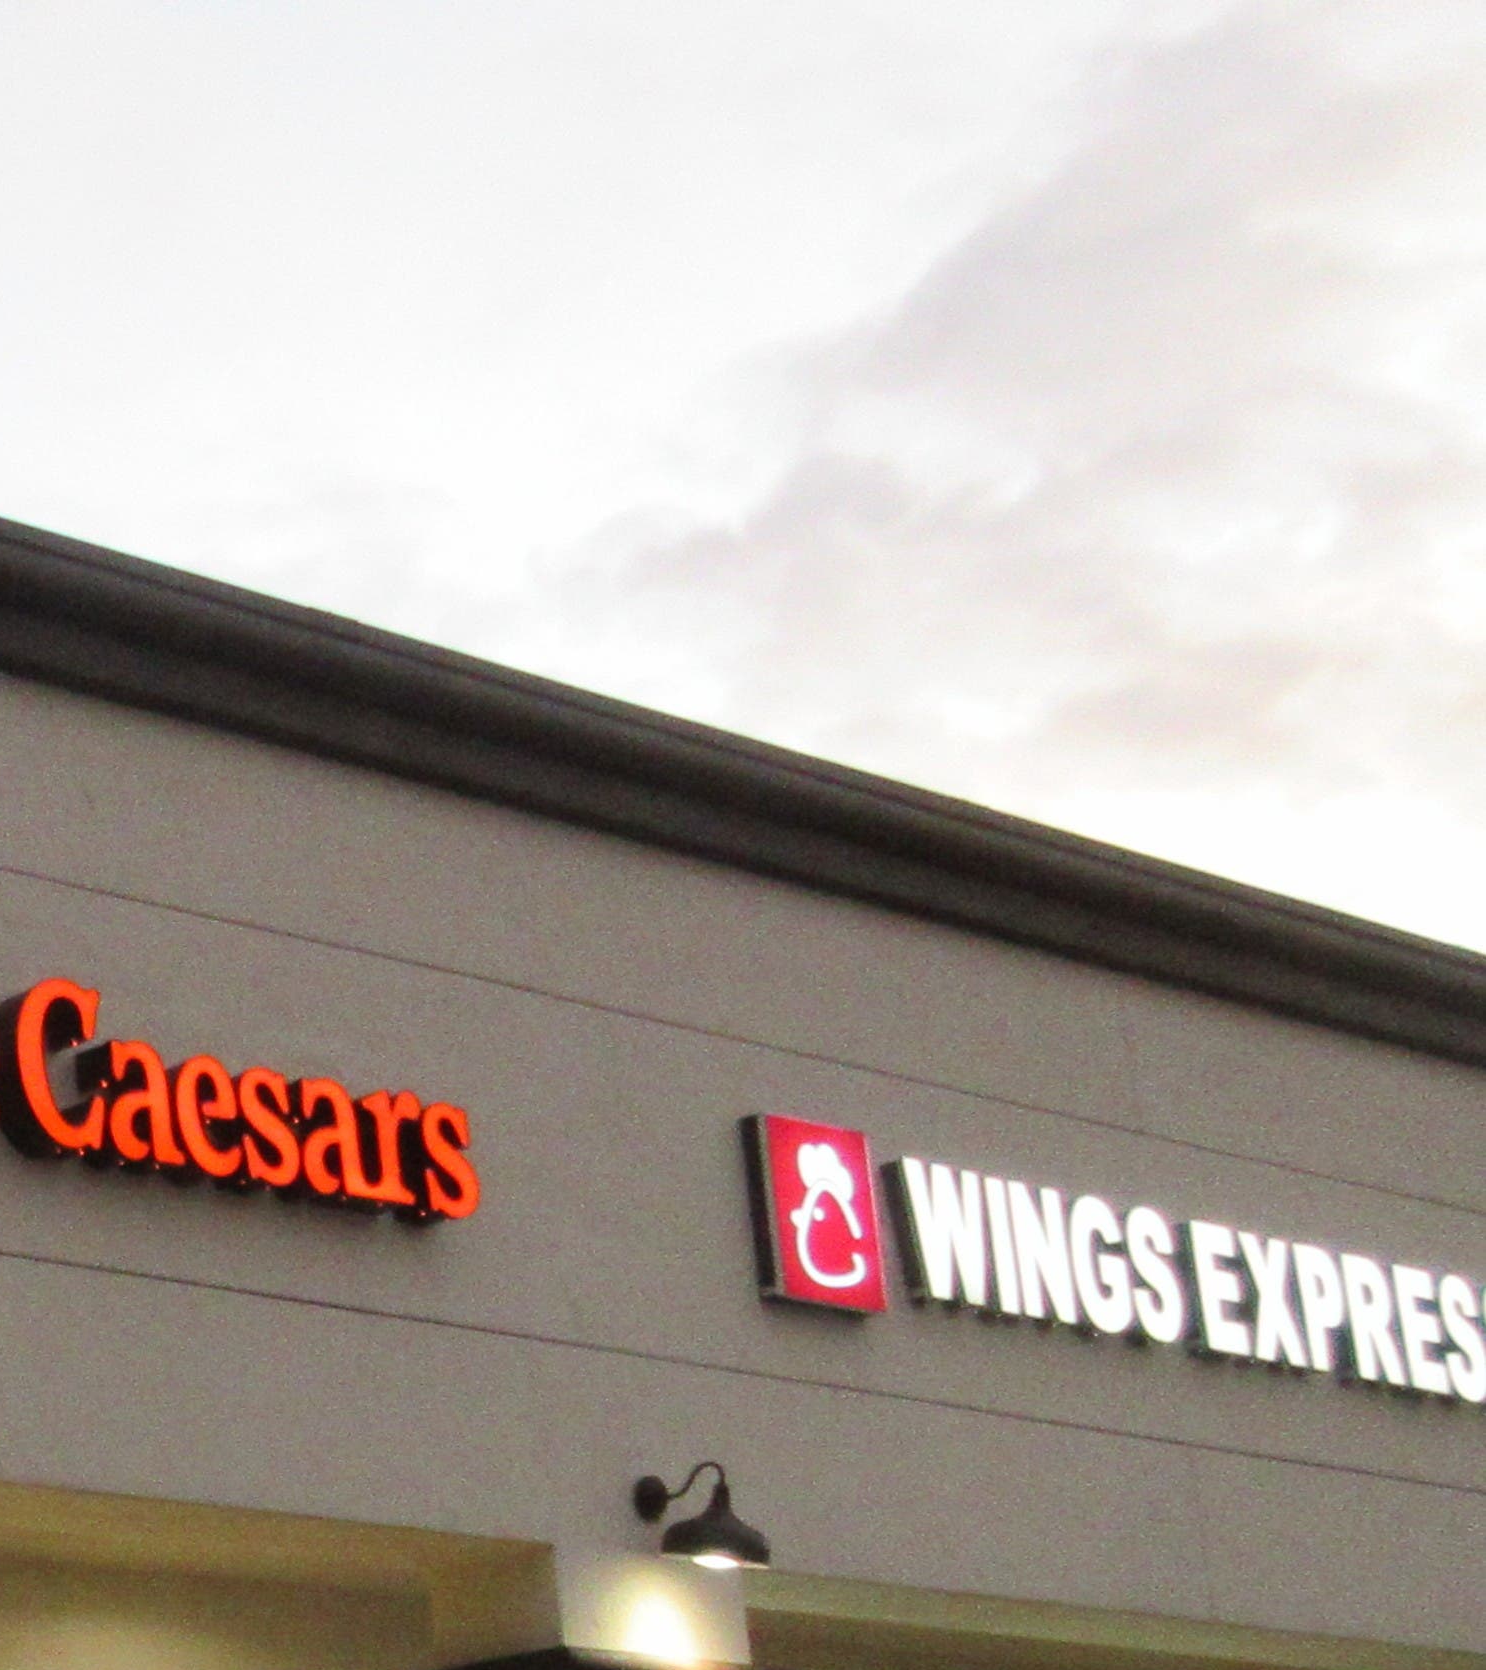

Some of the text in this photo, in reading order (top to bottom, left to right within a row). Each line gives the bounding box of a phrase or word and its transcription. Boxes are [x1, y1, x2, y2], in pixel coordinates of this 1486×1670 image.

[13, 976, 479, 1220] Caesars
[900, 1155, 1486, 1405] WINGS EXPRES
